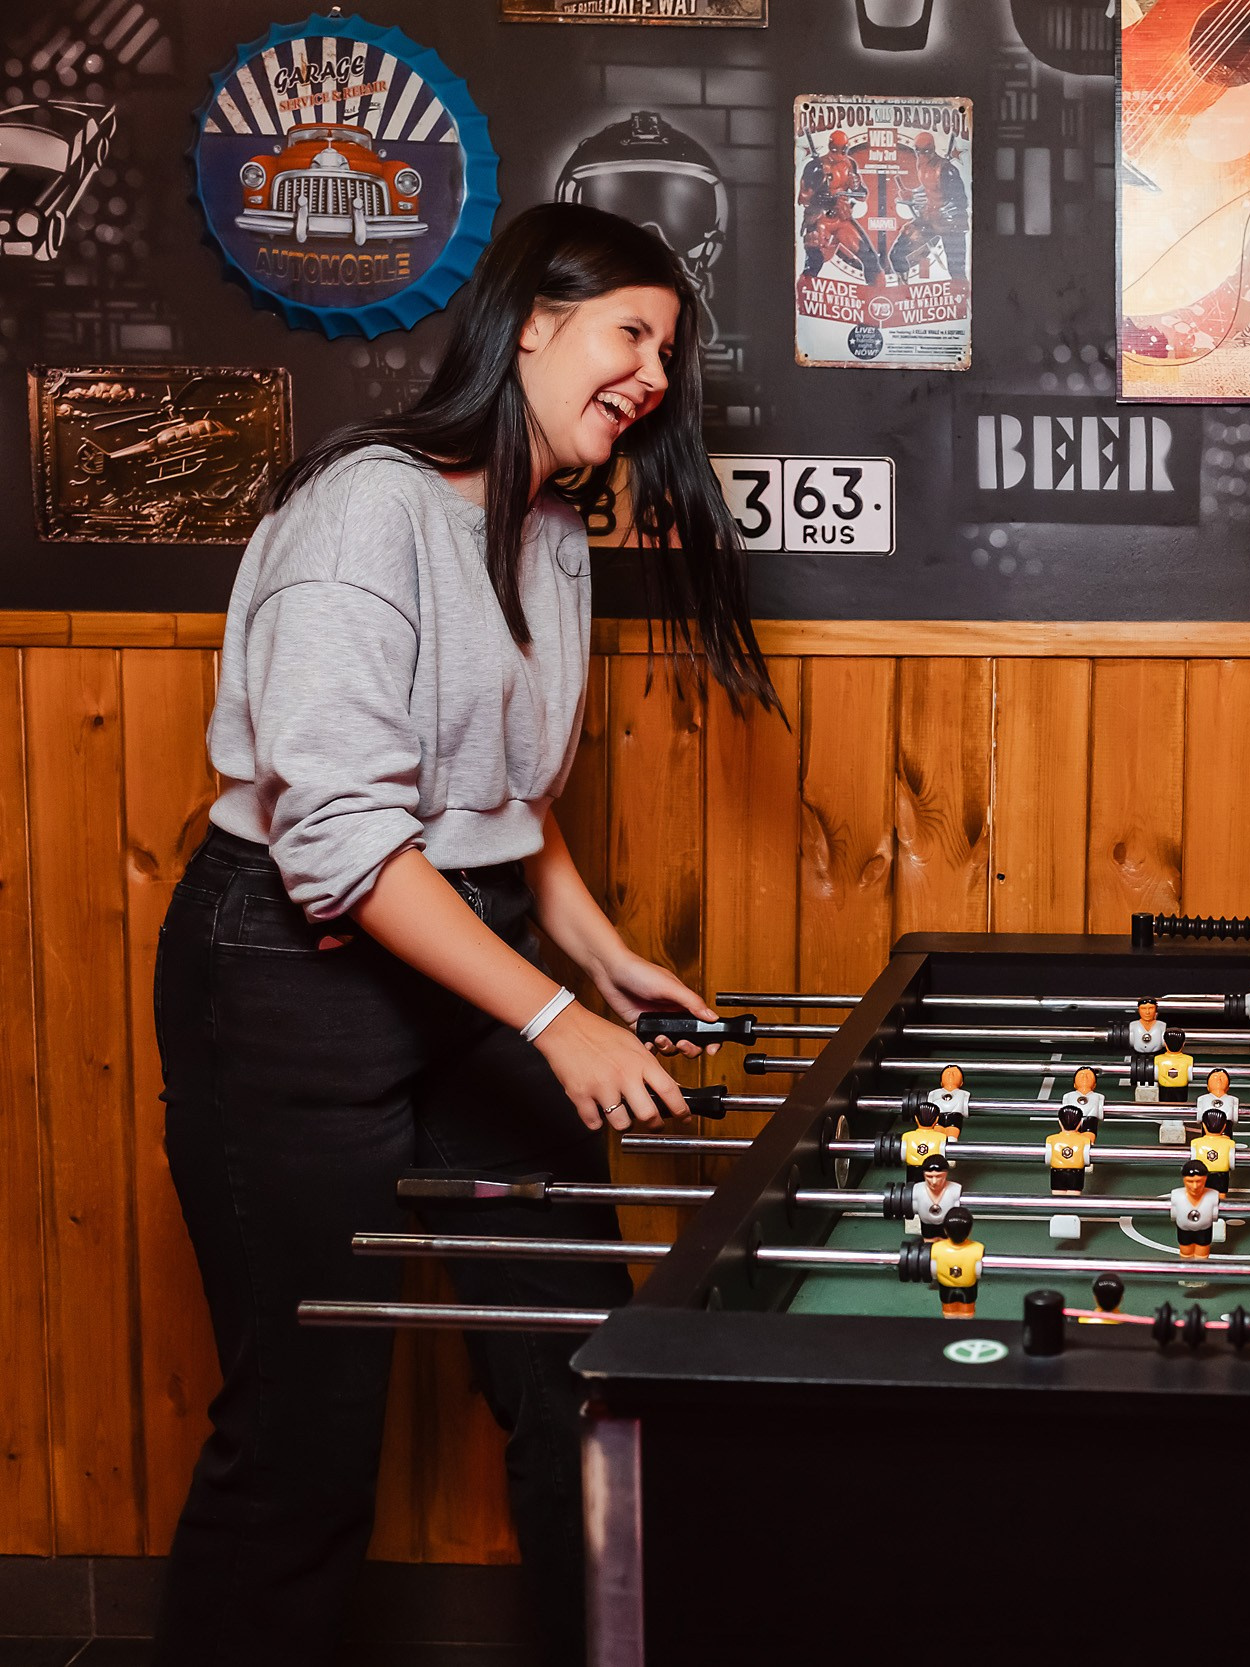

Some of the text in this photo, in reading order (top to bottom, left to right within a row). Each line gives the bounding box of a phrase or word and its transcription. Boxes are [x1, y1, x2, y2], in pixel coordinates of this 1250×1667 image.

[274, 55, 365, 95] GARAGE
[279, 80, 387, 112] SERVICE & REPAIR
[798, 105, 873, 137] DEADPOOL
[893, 106, 969, 141] DEADPOOL
[869, 130, 897, 147] WED.
[255, 247, 410, 286] AUTOMOBILE
[811, 278, 858, 299] WADE
[909, 282, 951, 299] WADE
[804, 300, 864, 323] WILSON
[902, 305, 957, 323] WILSON
[977, 414, 1175, 491] BEER
[793, 466, 863, 520] 63
[802, 525, 855, 544] RUS
